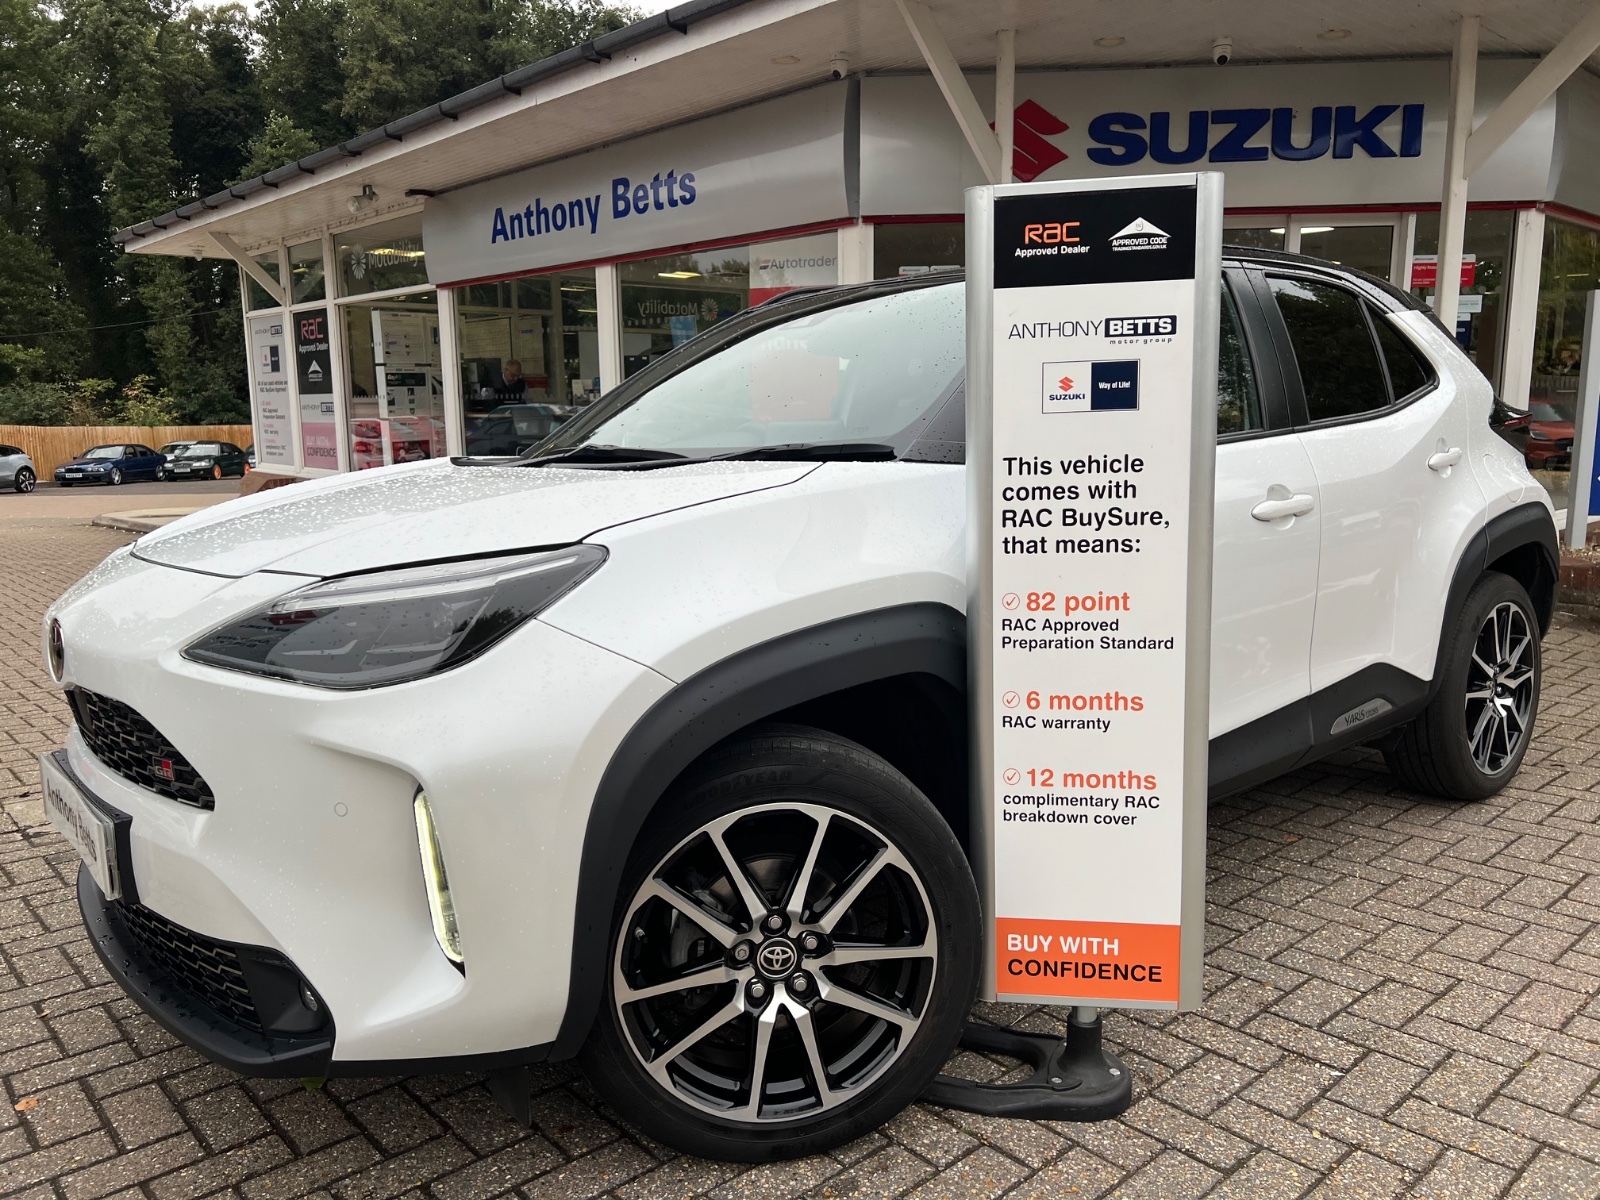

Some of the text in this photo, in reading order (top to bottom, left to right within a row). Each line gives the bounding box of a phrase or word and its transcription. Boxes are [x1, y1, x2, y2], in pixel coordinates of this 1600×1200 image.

[1086, 103, 1425, 166] SUZUKI
[491, 169, 697, 244] Anthony Betts
[1111, 236, 1168, 247] APPROVED CODE
[368, 240, 419, 270] Motability
[1014, 244, 1090, 258] Approved Dealer
[769, 255, 837, 270] Autotrader
[1008, 317, 1172, 340] ANTHONY BETTS
[1142, 337, 1173, 345] group
[1098, 381, 1131, 390] Way of Life!
[1048, 393, 1086, 401] SUZUKI
[1002, 453, 1144, 476] This vehicle
[1002, 479, 1137, 502] comes with
[1002, 506, 1170, 531] RAC BuySure,
[1002, 536, 1141, 554] that means:
[1026, 591, 1131, 617] 82 point
[1001, 618, 1119, 635] RAC Approved
[1001, 636, 1175, 652] Preparation Standard
[1026, 690, 1144, 711] 6 months
[1002, 715, 1111, 733] RAC warranty
[1344, 709, 1365, 727] YARIS
[155, 765, 174, 780] GR
[1026, 768, 1157, 790] 12 months
[1003, 793, 1160, 811] complimentary RAC
[1003, 809, 1138, 826] breakdown cover
[1007, 933, 1119, 956] BUY WITH
[1007, 958, 1163, 983] CONFIDENCE
